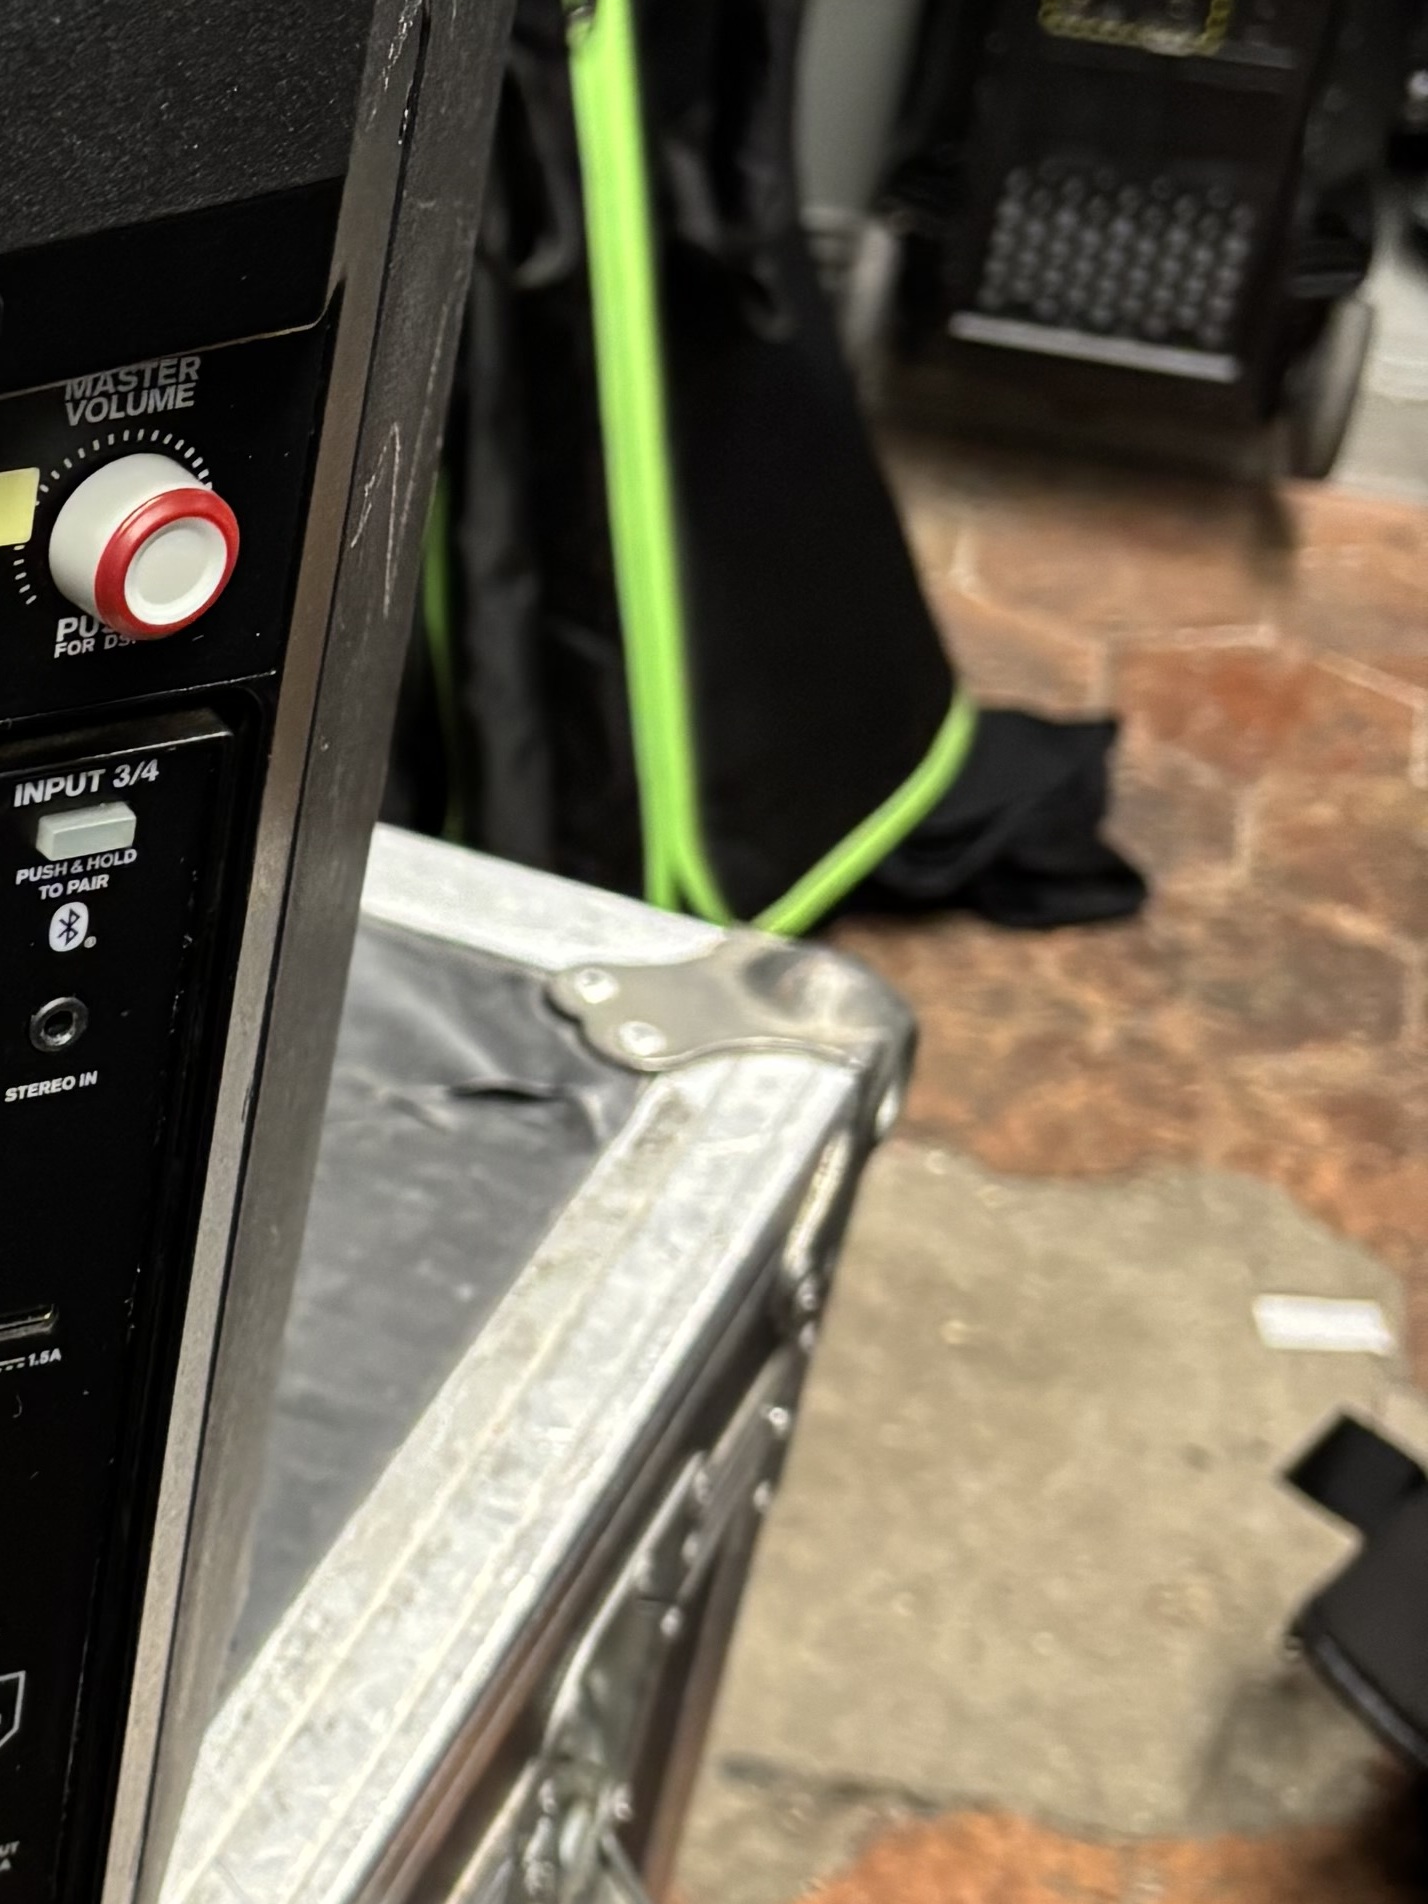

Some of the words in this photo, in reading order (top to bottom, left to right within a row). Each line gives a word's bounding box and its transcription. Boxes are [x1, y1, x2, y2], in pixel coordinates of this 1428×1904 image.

[64, 356, 201, 401] MASTER
[65, 382, 196, 427] VOLUME
[53, 637, 96, 659] FOR
[104, 633, 137, 650] DS
[56, 615, 116, 643] PU
[14, 769, 106, 809] INPUT
[112, 758, 160, 794] 3/4
[15, 861, 70, 886] PUSH
[72, 859, 85, 875] &
[87, 848, 138, 873] HOLD
[38, 881, 66, 901] TO
[68, 874, 110, 896] PAIR
[4, 1076, 76, 1104] STEREO
[78, 1070, 98, 1088] IN
[28, 1347, 62, 1368] 1.5A
